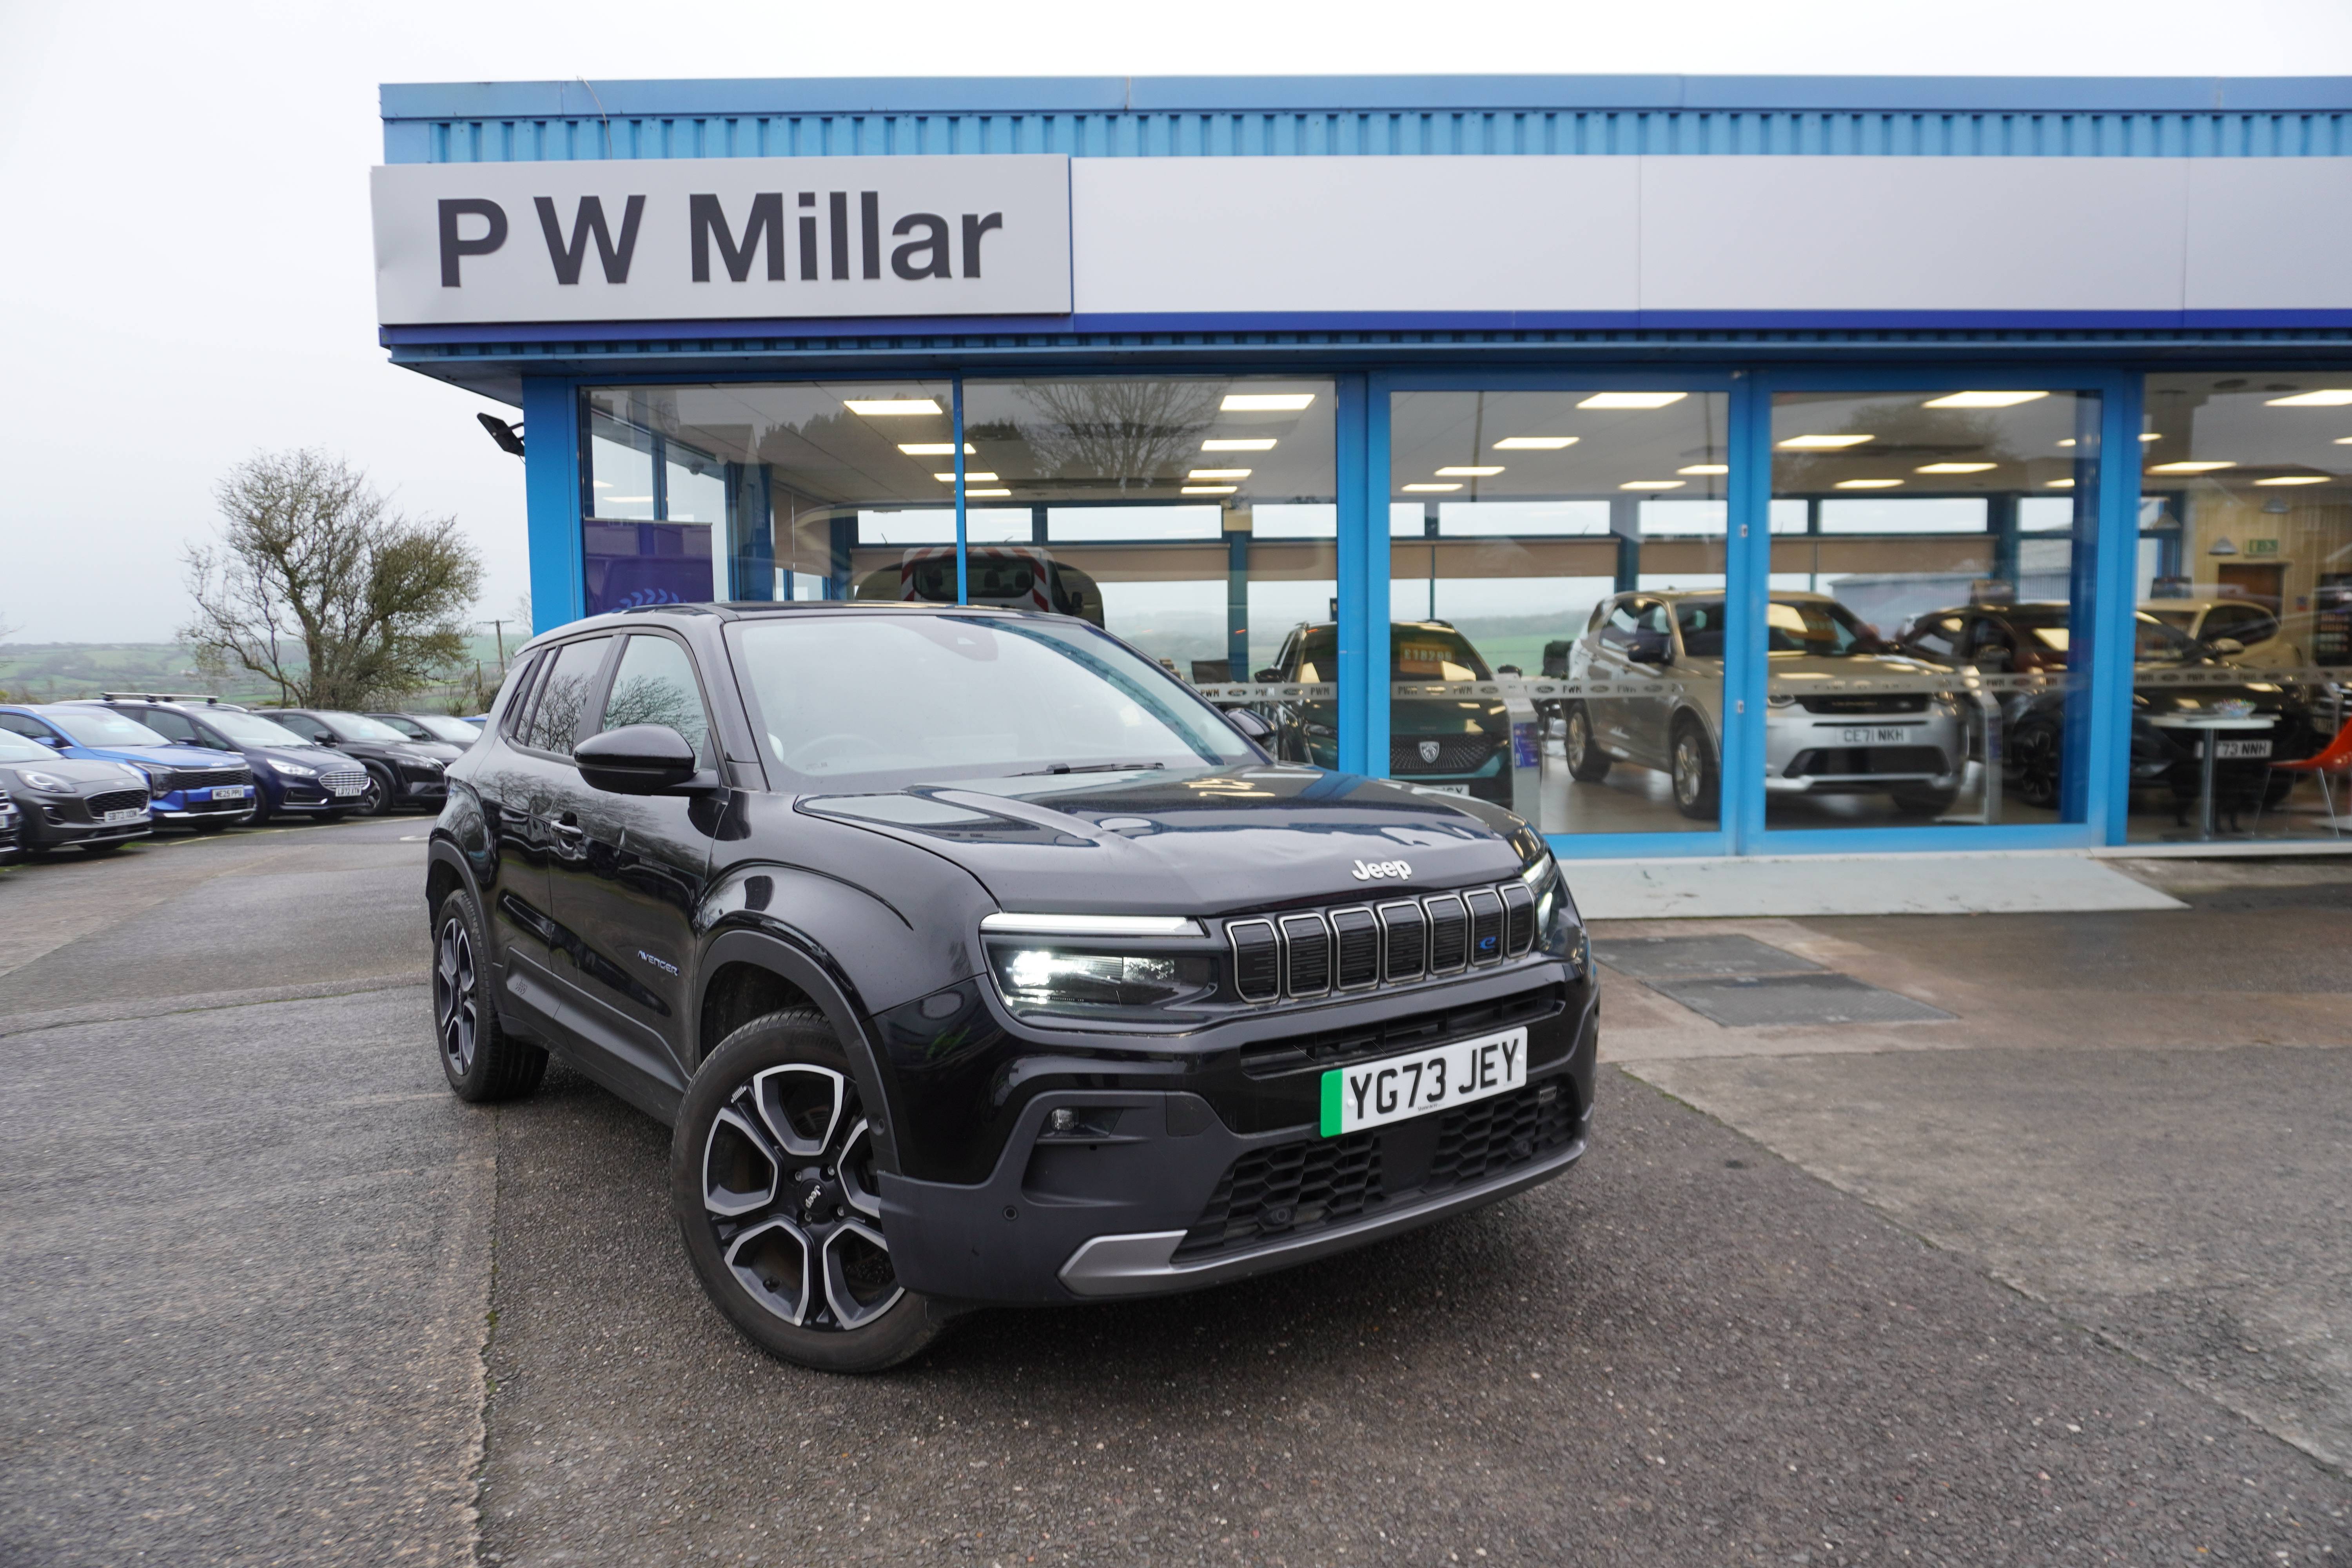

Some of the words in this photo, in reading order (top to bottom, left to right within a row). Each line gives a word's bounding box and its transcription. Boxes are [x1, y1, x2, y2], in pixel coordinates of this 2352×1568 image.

[438, 199, 508, 288] P
[533, 194, 646, 284] W
[689, 191, 1002, 283] Millar
[1201, 688, 1220, 697] PWM
[1310, 687, 1329, 695] PWM
[1563, 685, 1582, 693] PWM
[1844, 730, 1874, 742] CE71
[1878, 729, 1904, 741] NKH
[2242, 743, 2267, 755] NNH
[1352, 859, 1412, 881] Jeep
[638, 950, 678, 976] AVENGER
[1350, 1058, 1447, 1120] YG73
[1458, 1038, 1519, 1094] JEY
[806, 1185, 821, 1209] Jeep
